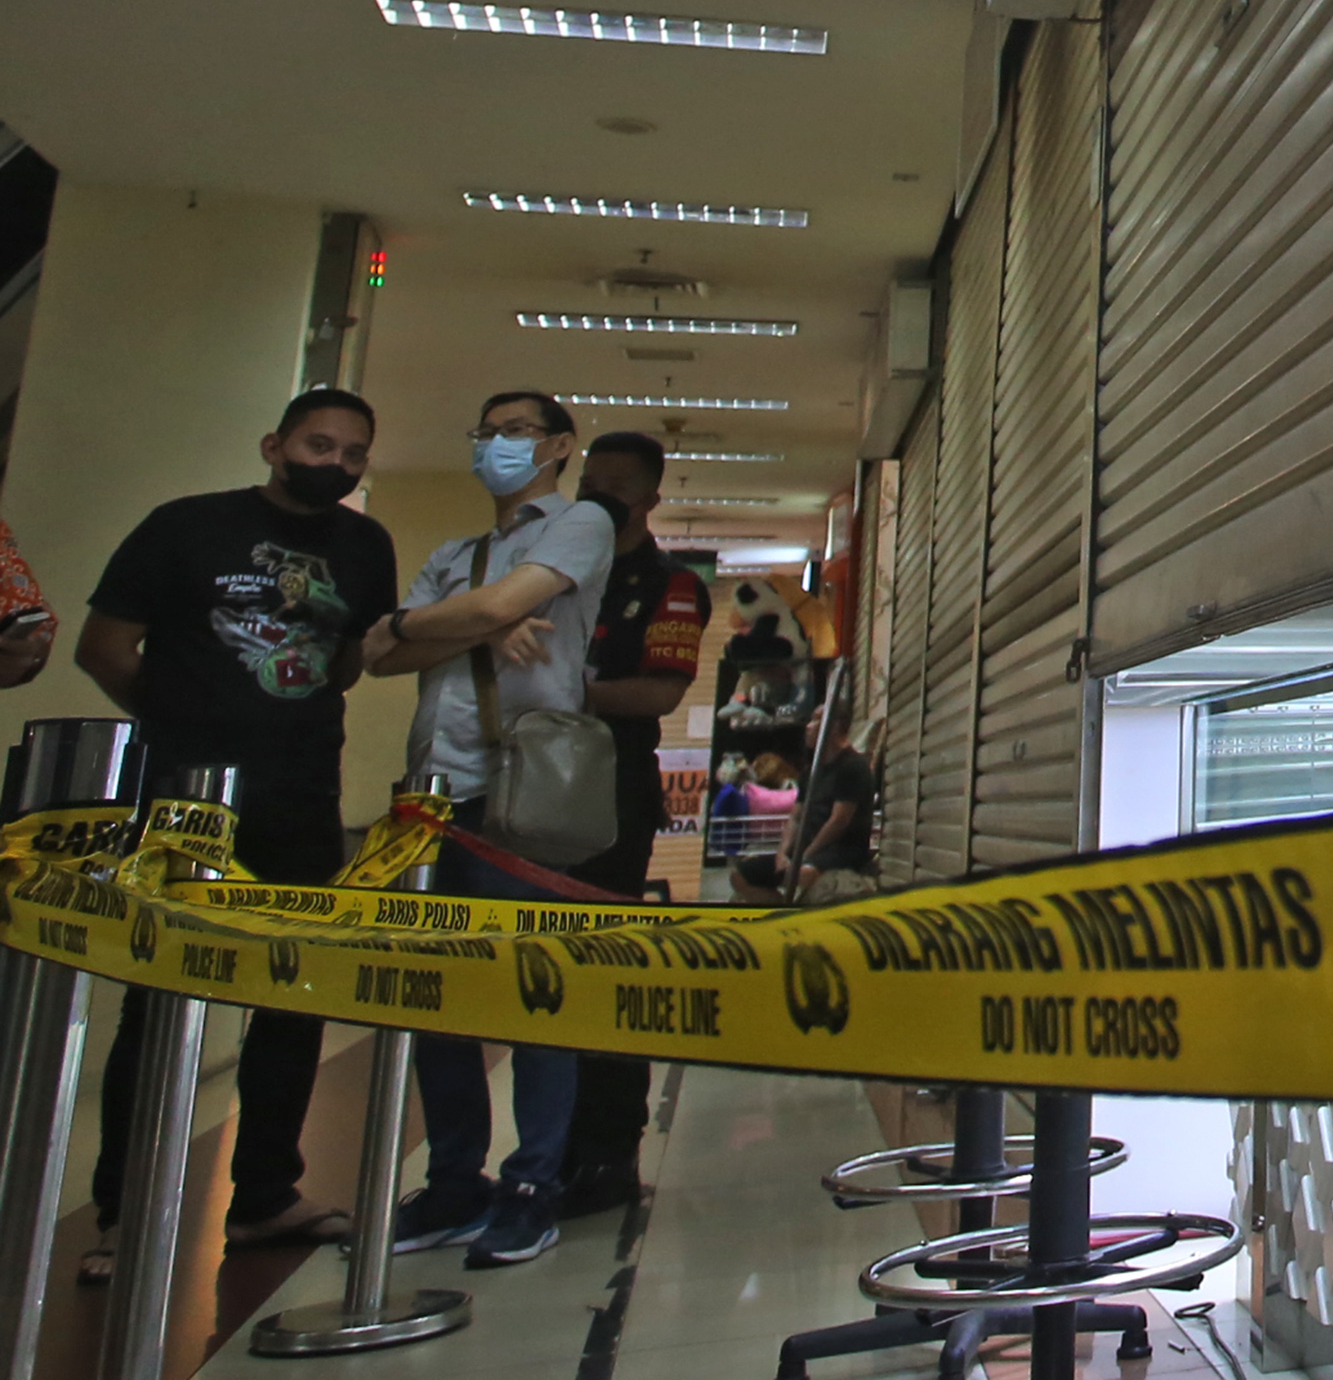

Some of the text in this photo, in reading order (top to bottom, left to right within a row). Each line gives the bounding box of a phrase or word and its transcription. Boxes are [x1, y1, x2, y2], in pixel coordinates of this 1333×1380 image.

[375, 896, 471, 932] GARIS POLISI
[842, 866, 1325, 975] DILARANG MELINTAS
[355, 963, 444, 1013] DO NOT CROSS
[616, 983, 722, 1038] POLICE LINE
[981, 996, 1181, 1061] DO NOT CROSS
